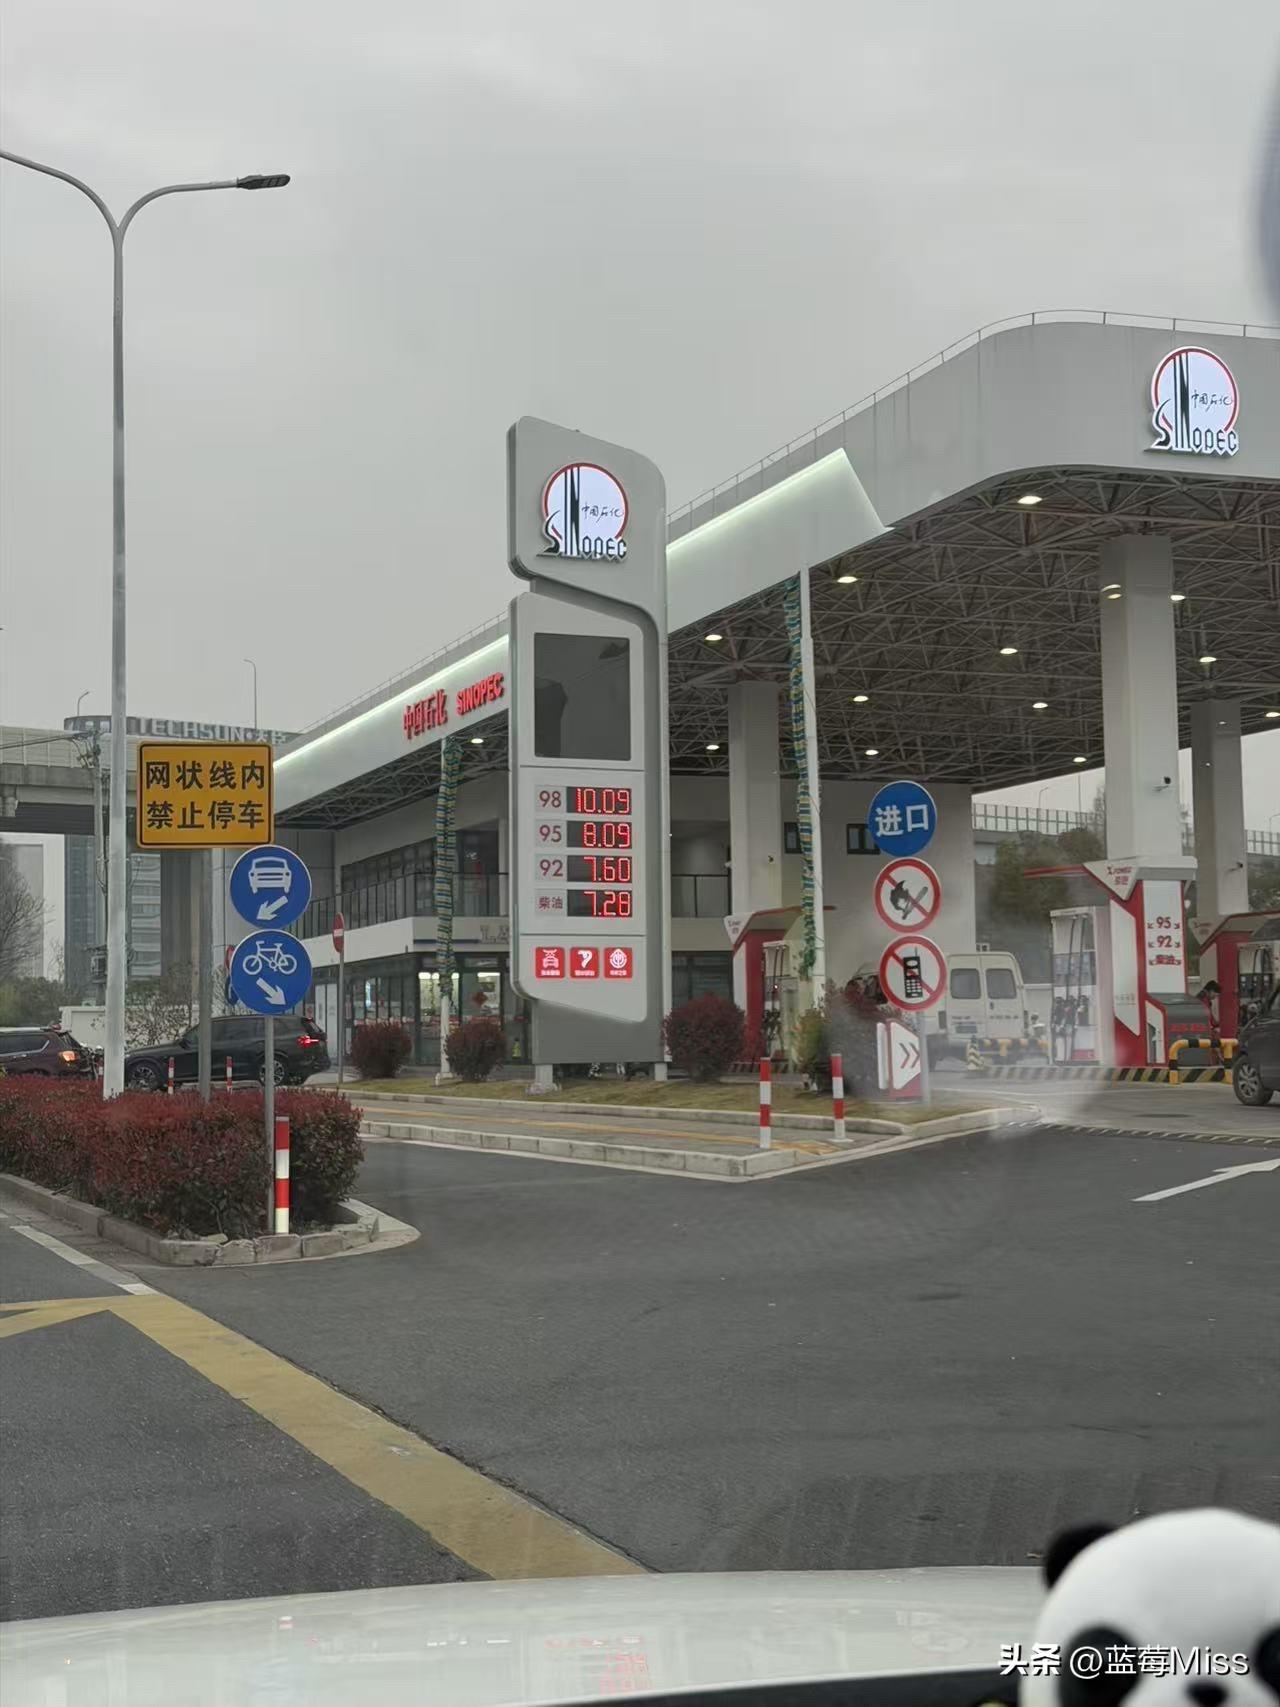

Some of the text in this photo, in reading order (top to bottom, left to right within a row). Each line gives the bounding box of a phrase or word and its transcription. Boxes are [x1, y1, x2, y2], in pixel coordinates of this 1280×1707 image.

[456, 672, 504, 715] SINOPEC
[145, 759, 266, 791] 网状线内
[539, 788, 631, 814] 98 10.09
[146, 801, 265, 830] 禁止停车
[875, 803, 930, 837] 进口
[539, 822, 631, 848] 95 8.09
[539, 856, 631, 882] 92 7.60
[538, 891, 631, 916] 柴油 7.28
[1155, 916, 1172, 929] 95
[1156, 935, 1172, 948] 92
